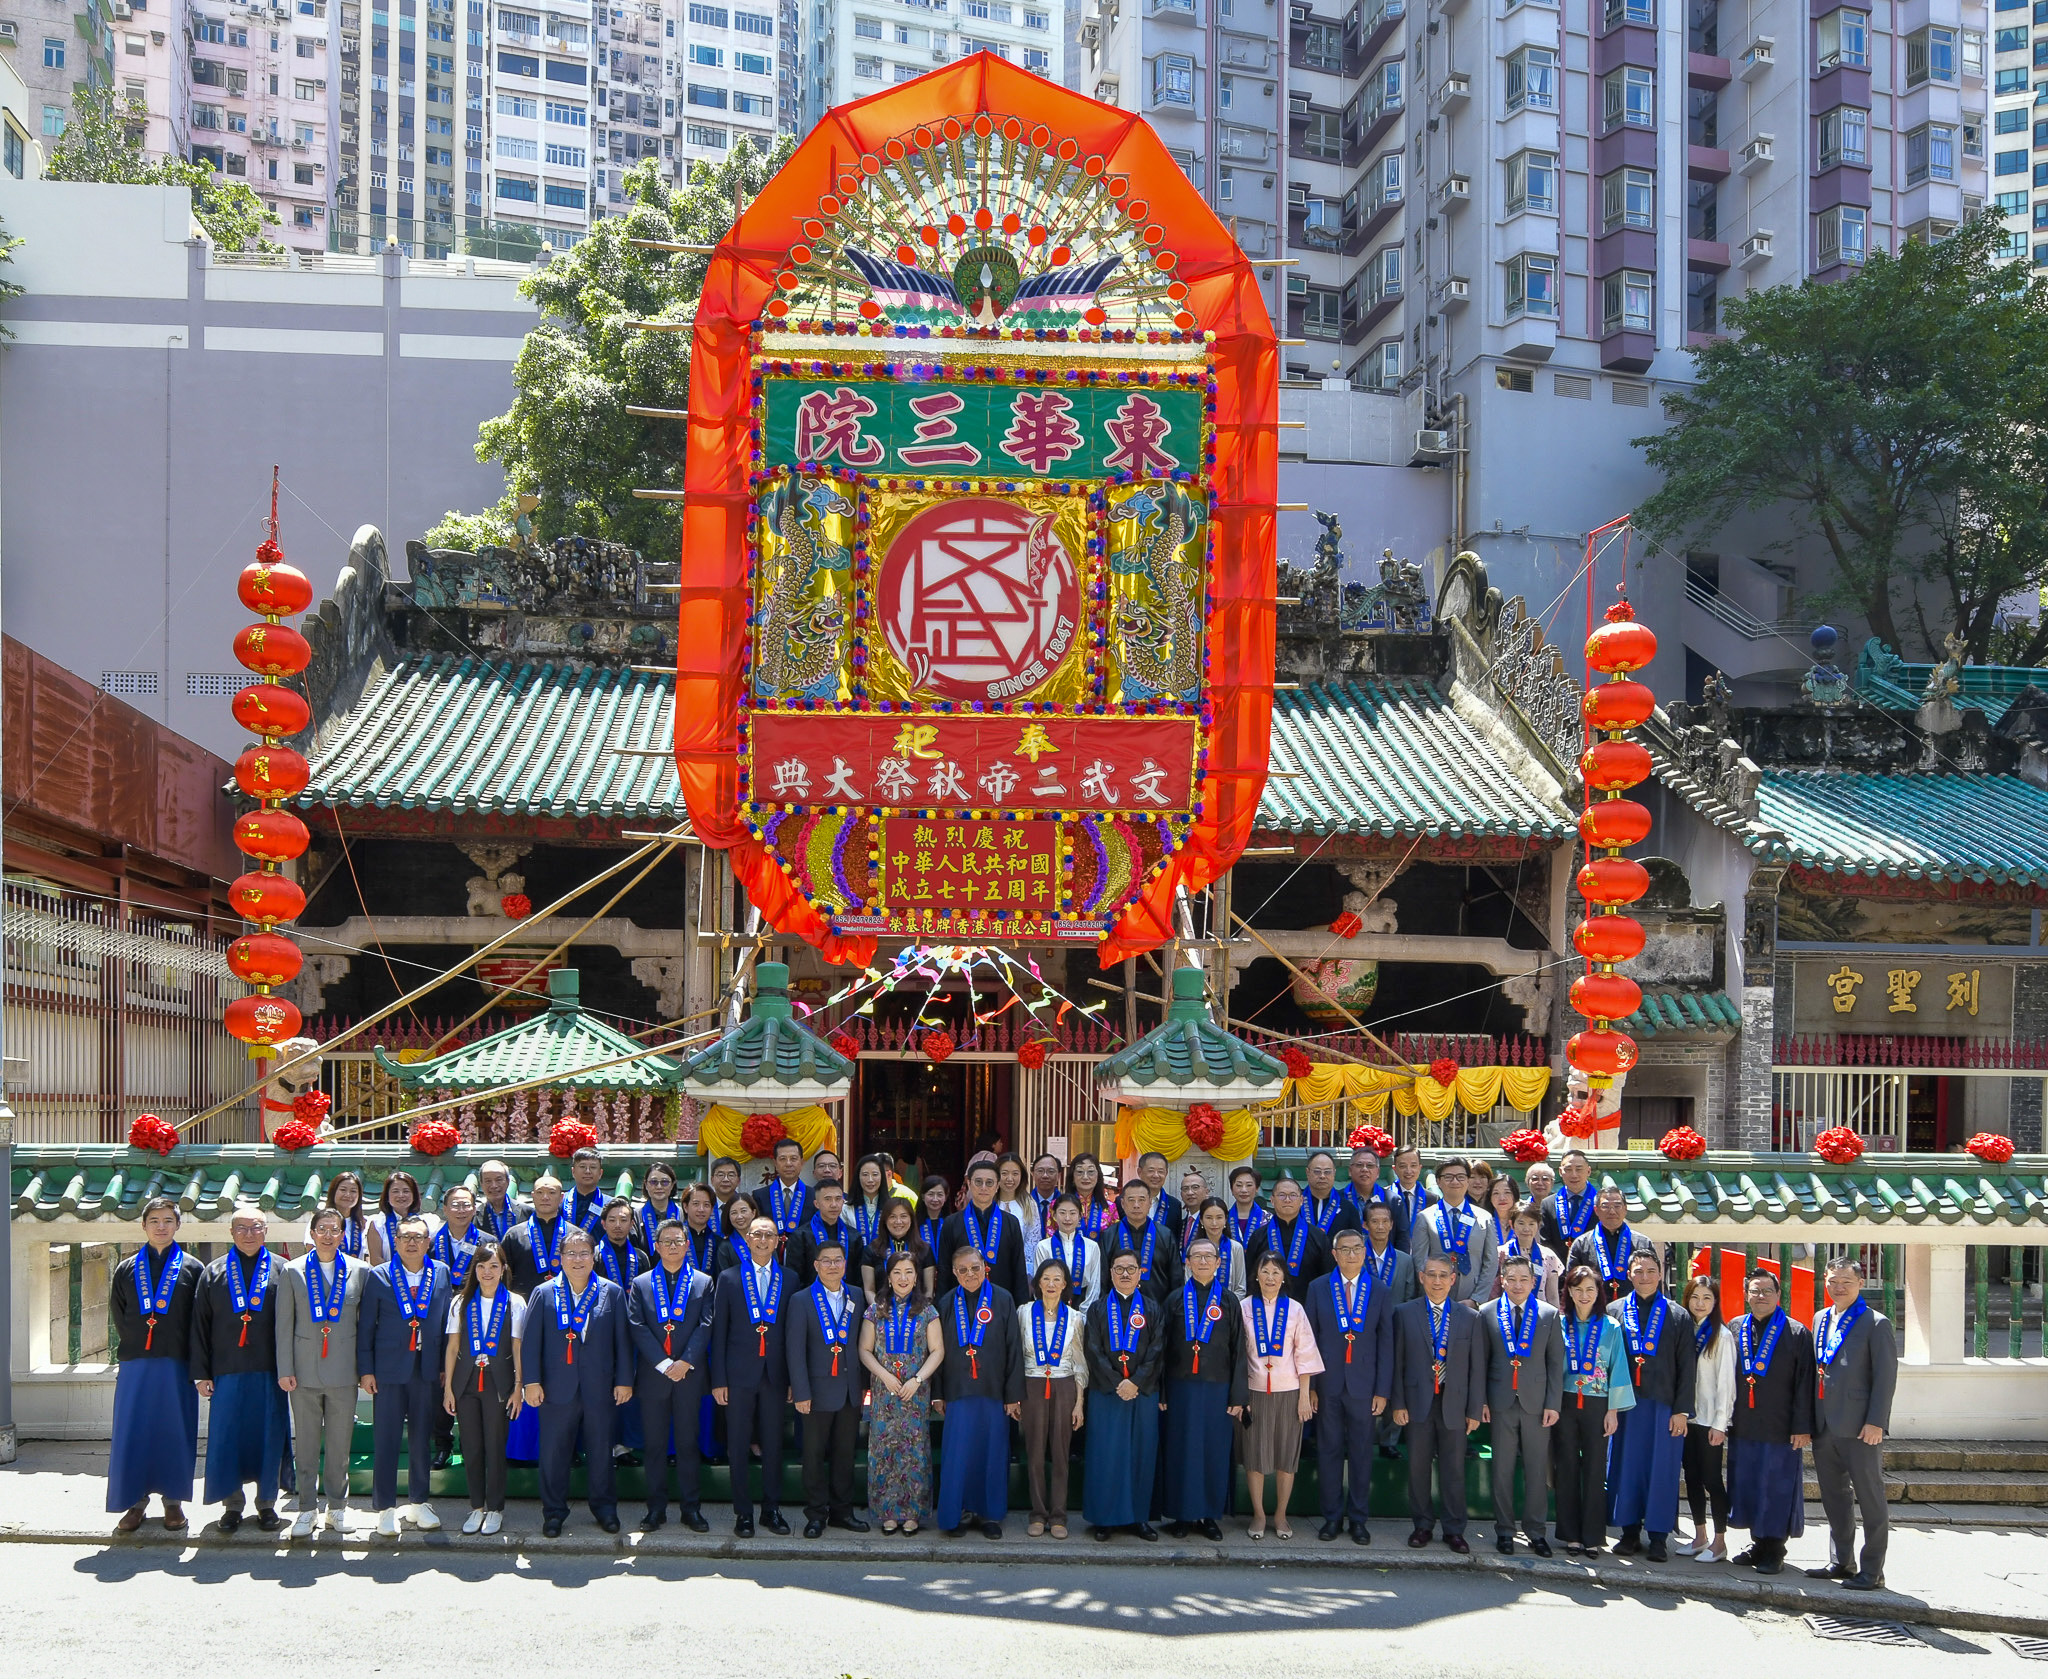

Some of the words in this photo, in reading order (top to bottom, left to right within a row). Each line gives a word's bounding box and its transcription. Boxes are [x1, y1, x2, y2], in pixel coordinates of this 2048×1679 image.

[795, 386, 1180, 474] 東華三院
[986, 660, 1048, 699] SINCE
[1044, 615, 1074, 662] 1847
[893, 722, 1060, 762] 奉祀
[770, 755, 1172, 805] 文武二帝秋祭大典
[912, 824, 1029, 850] 熱烈慶祝
[891, 850, 1050, 876] 中華人民共和國
[890, 877, 1050, 903] 成立七十五周年
[888, 916, 1052, 936] 榮基花牌(香港)有限公司
[1827, 965, 1981, 1016] 列聖宮
